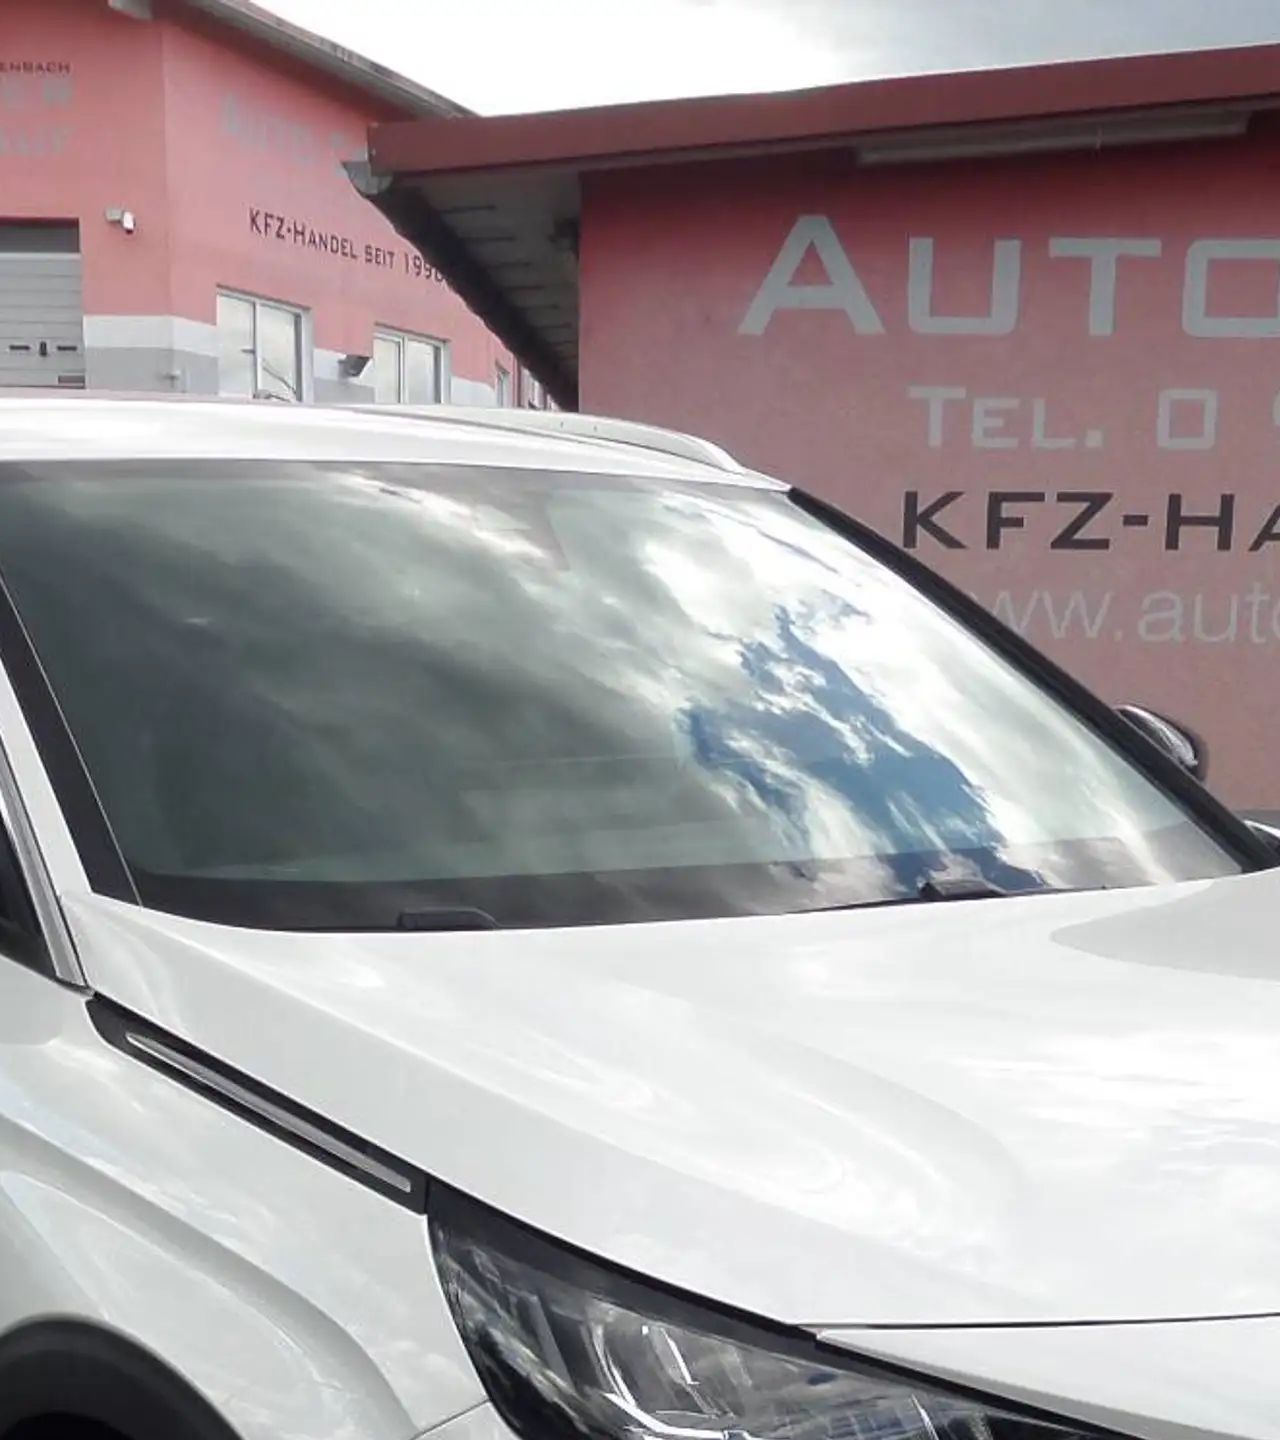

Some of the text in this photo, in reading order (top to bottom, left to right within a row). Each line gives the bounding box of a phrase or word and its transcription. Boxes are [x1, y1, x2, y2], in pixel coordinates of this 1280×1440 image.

[248, 206, 358, 260] KFZ-HANDEL
[364, 244, 395, 270] SEIT
[906, 385, 1104, 451] TEL.
[1156, 387, 1219, 452] 0
